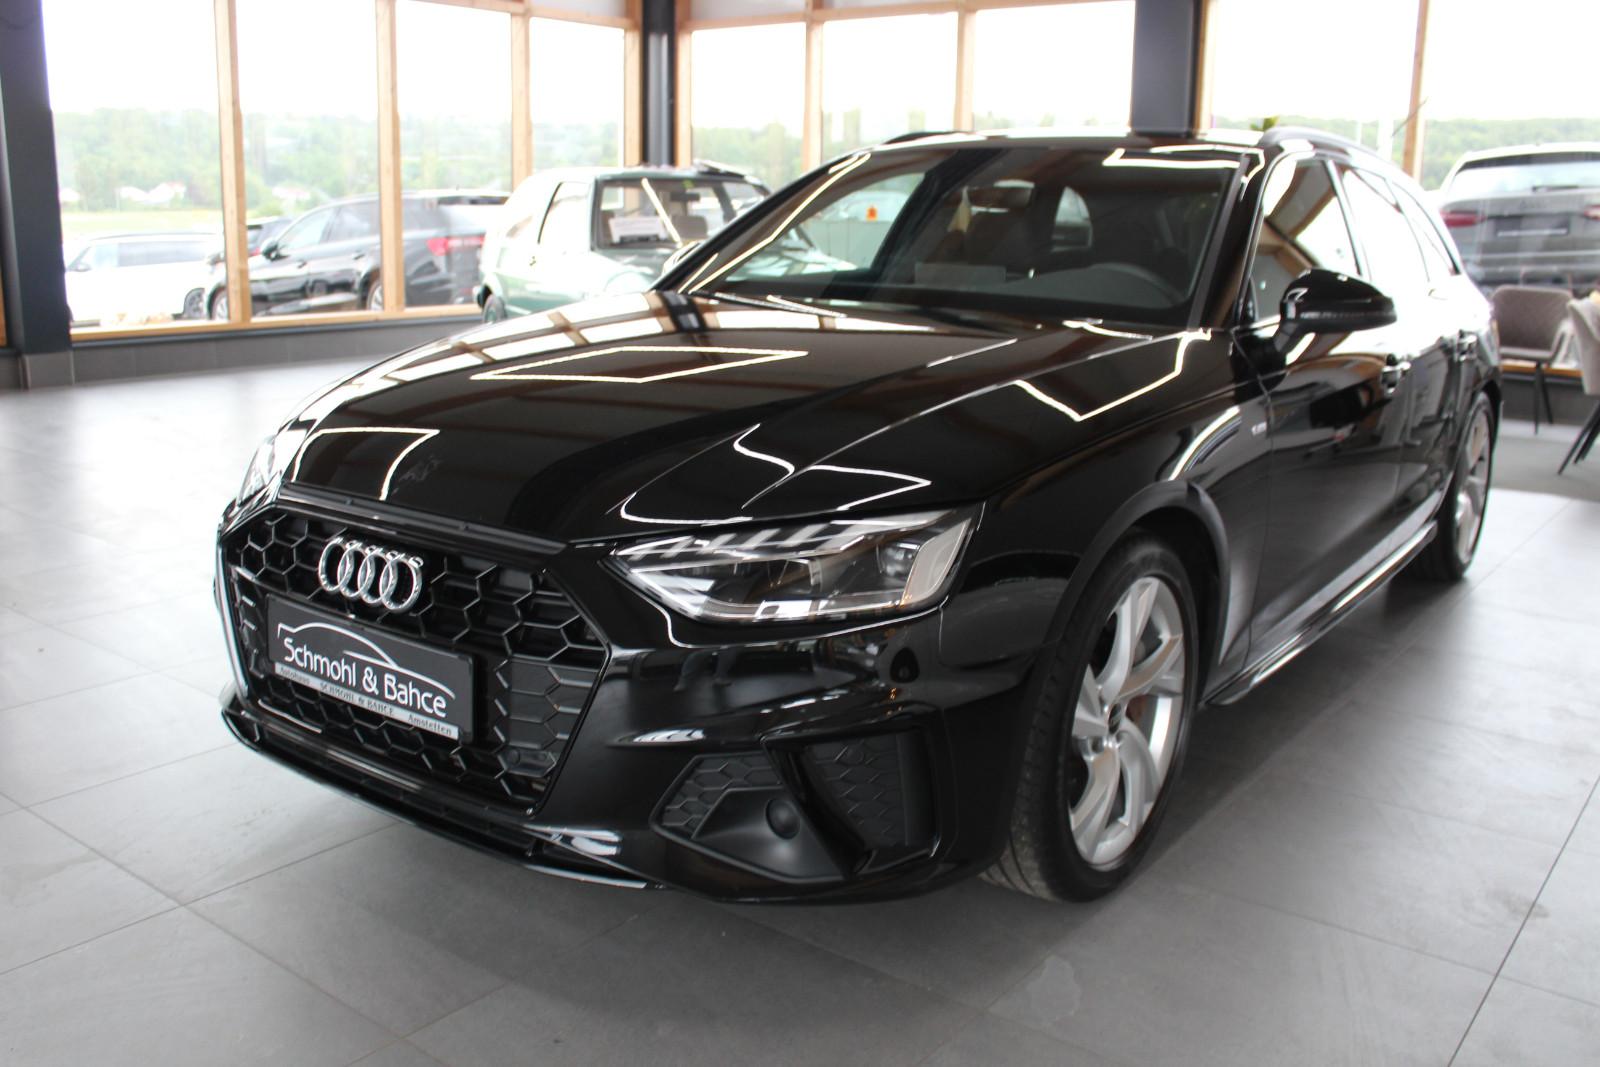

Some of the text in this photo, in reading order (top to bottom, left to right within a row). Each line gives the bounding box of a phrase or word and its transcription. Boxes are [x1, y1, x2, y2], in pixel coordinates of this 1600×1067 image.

[284, 637, 447, 718] Schmohl & Bahce
